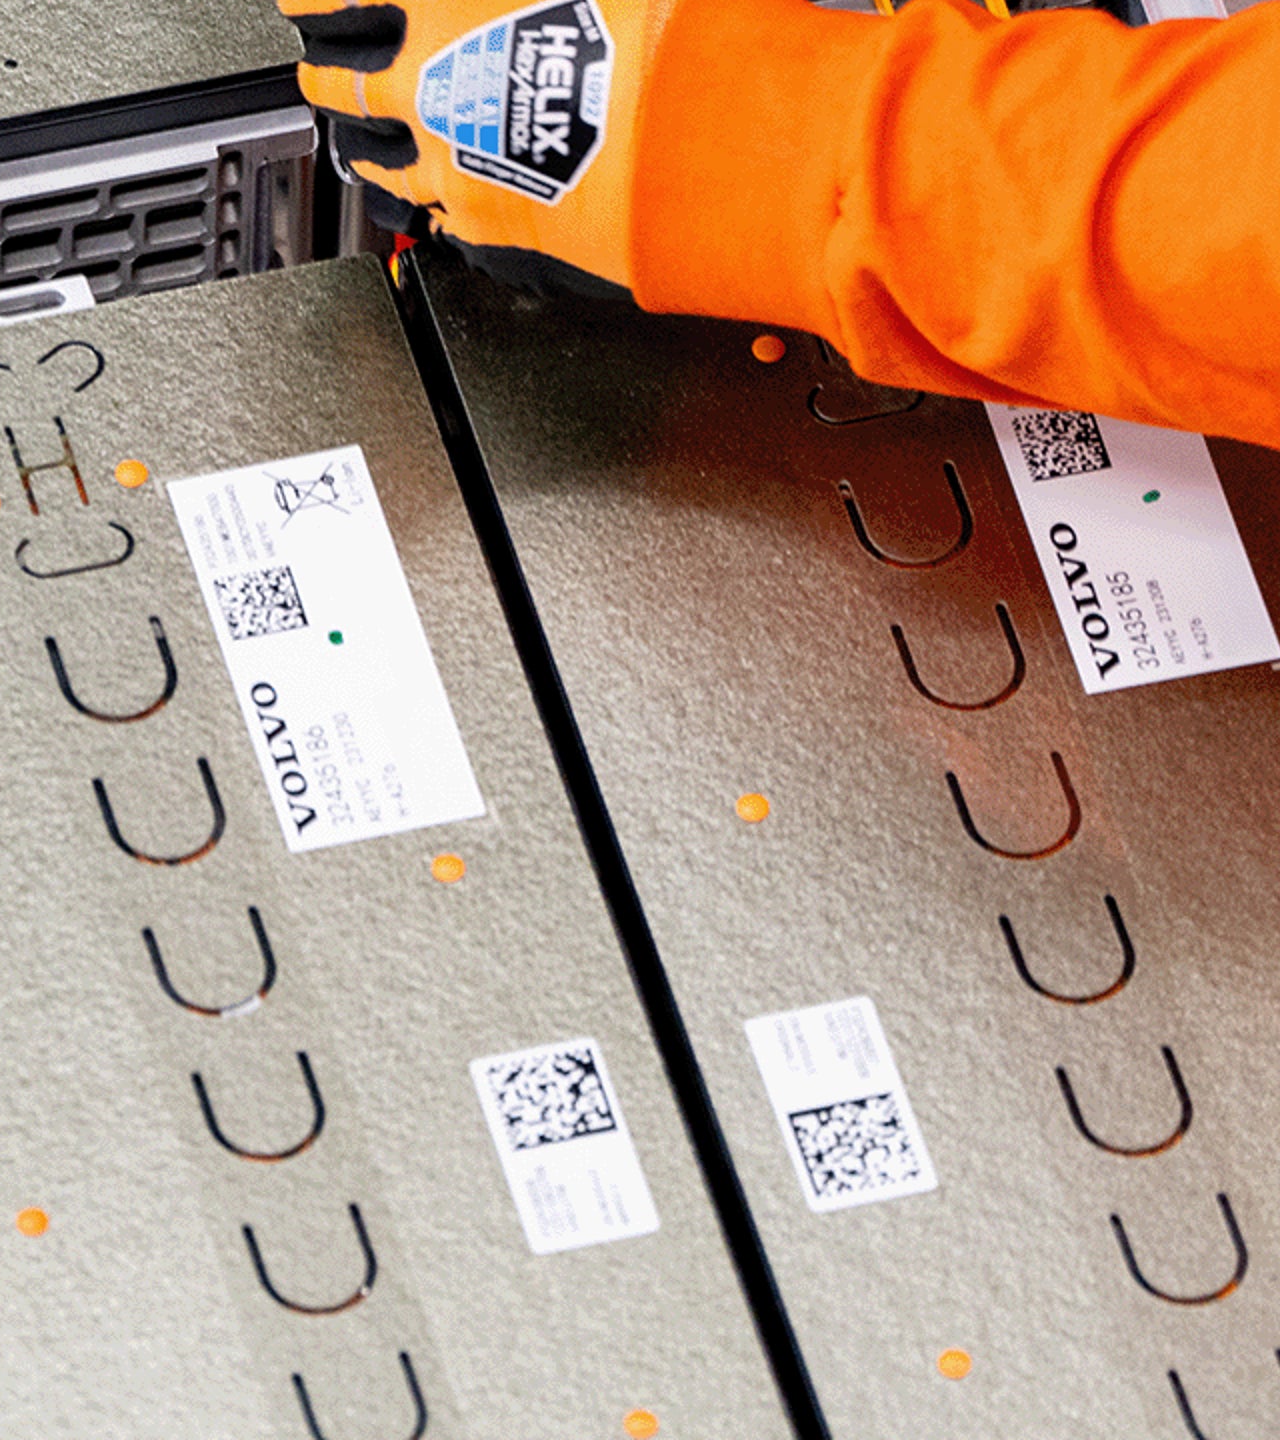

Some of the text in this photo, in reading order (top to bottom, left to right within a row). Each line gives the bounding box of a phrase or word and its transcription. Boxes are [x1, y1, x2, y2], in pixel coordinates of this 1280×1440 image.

[532, 24, 580, 156] HELIX
[1050, 522, 1120, 679] VOLVO
[1106, 571, 1160, 668] 32435185
[251, 682, 317, 834] VOLVO
[304, 725, 354, 826] 32435186
